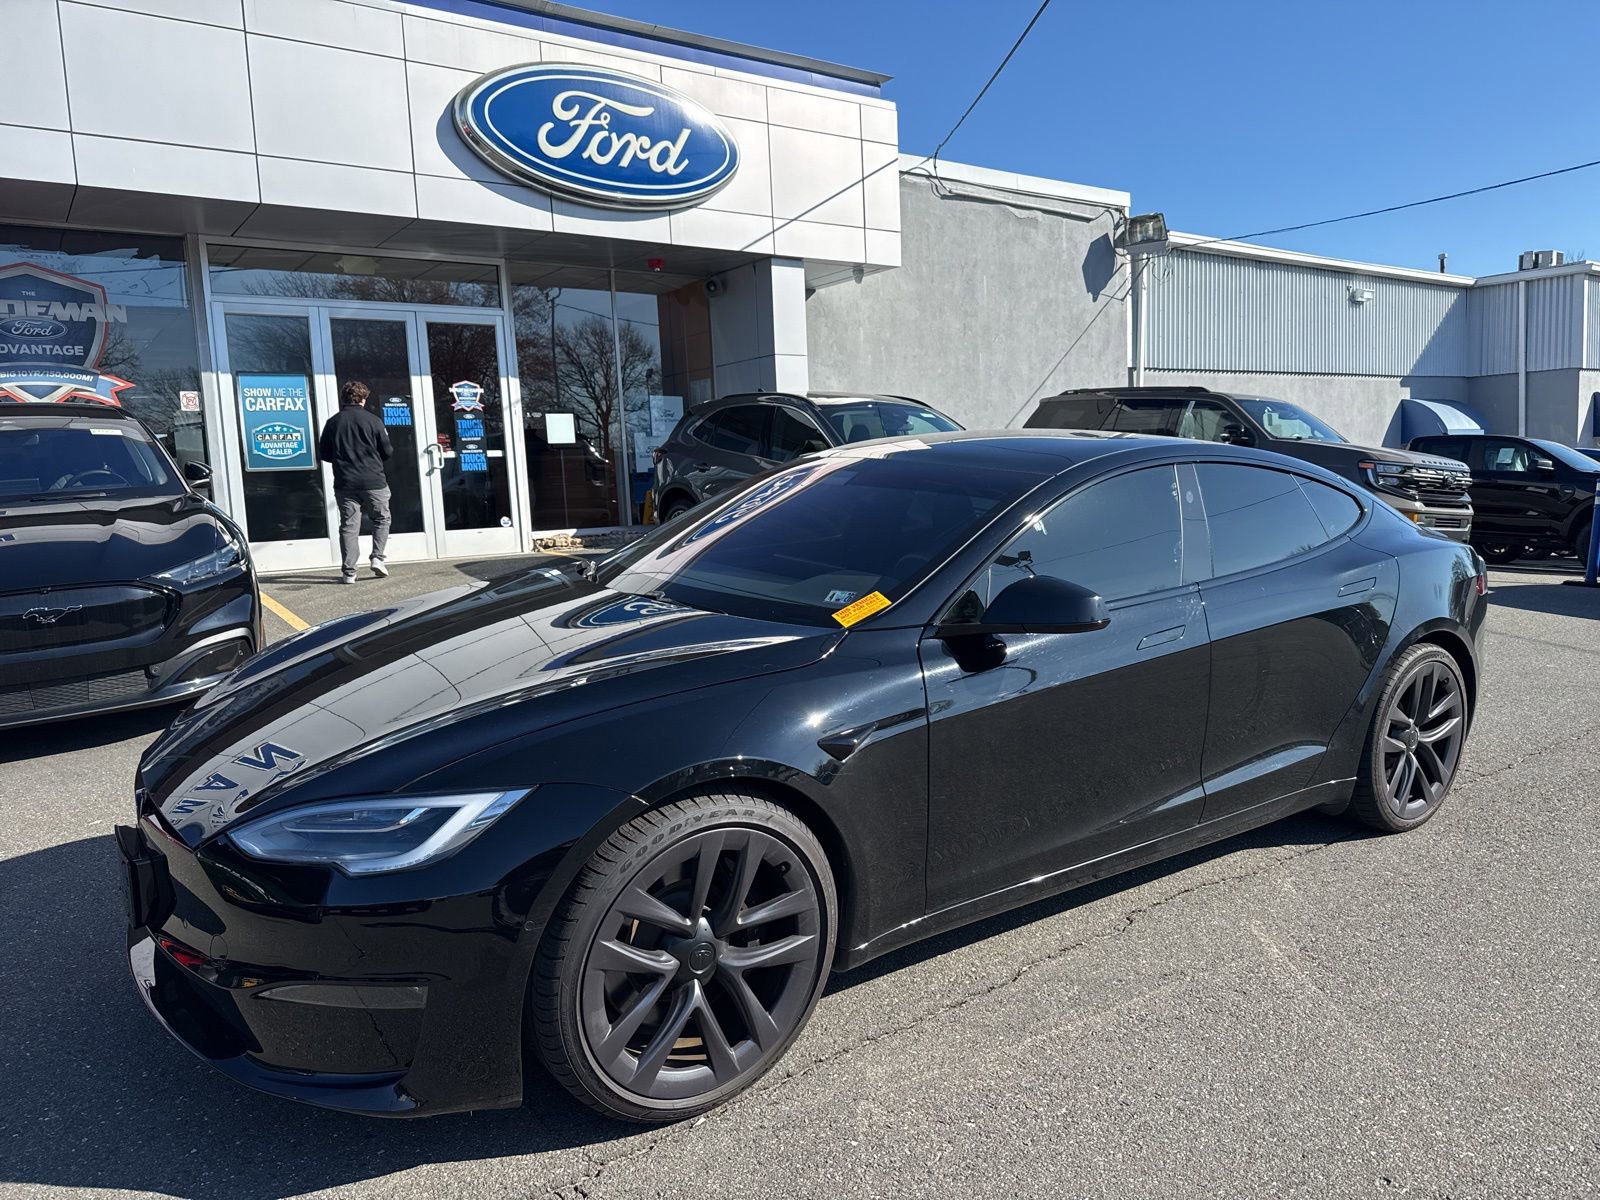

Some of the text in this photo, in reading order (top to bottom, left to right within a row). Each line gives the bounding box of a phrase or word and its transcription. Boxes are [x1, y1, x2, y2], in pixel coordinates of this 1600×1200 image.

[537, 90, 692, 176] Ford
[0, 299, 128, 323] DEMAN
[11, 320, 53, 336] Ford
[0, 343, 85, 356] DVANTAGE
[0, 370, 17, 378] BIG
[243, 387, 303, 398] SHOW ME THE
[245, 397, 305, 412] CARFAX
[382, 407, 411, 417] TRUCK
[383, 416, 412, 425] MONTH
[456, 419, 483, 429] TRUCK
[256, 432, 302, 441] CARFAX
[458, 428, 484, 437] MONTH
[260, 441, 299, 449] ADVANTAGE
[267, 448, 293, 456] DEALER
[460, 453, 486, 463] TRUCK
[461, 462, 487, 471] MONTH
[835, 607, 851, 616] THIS
[619, 808, 757, 874] GOODYEAR
